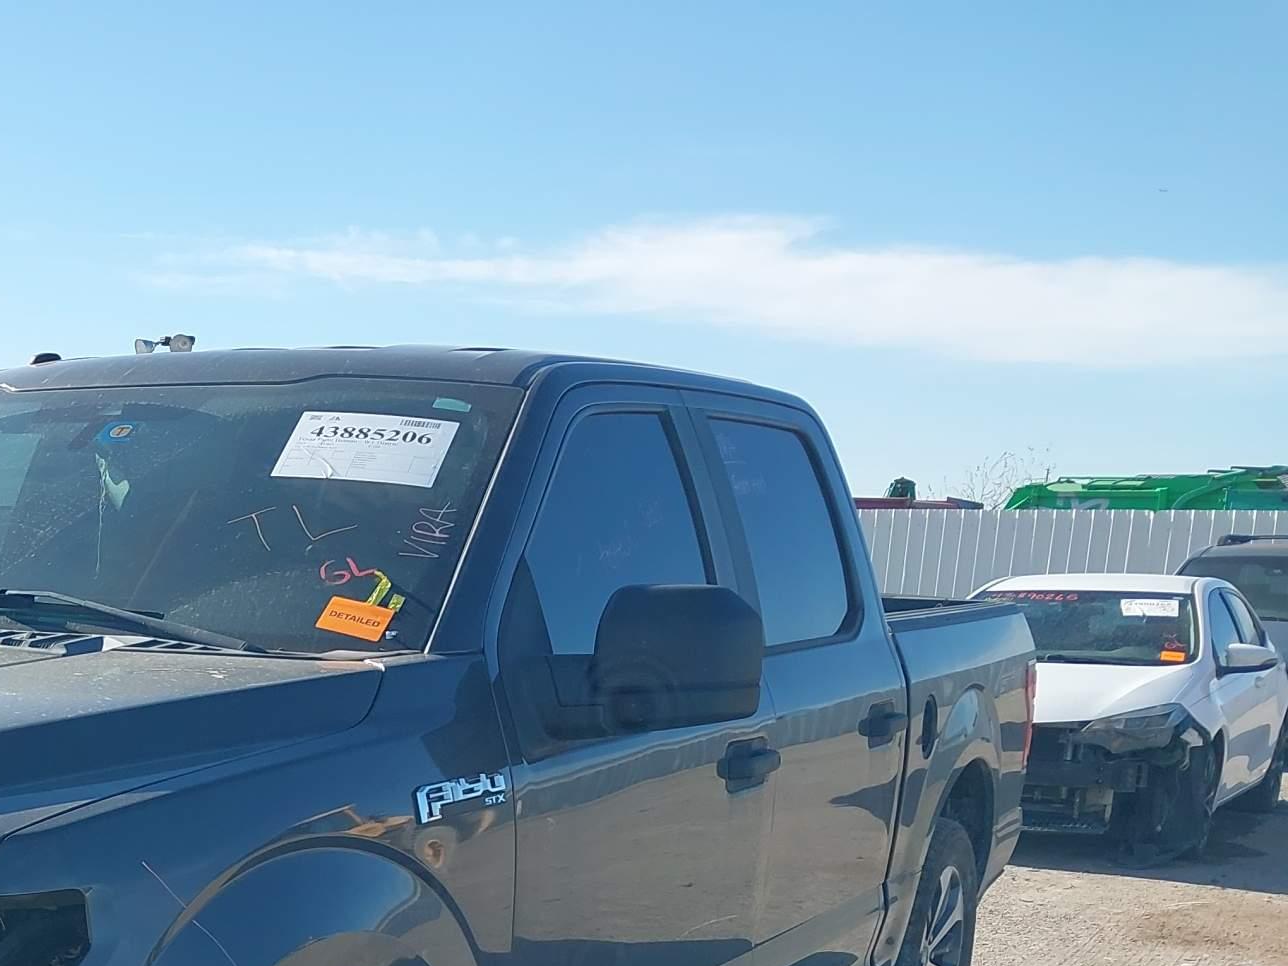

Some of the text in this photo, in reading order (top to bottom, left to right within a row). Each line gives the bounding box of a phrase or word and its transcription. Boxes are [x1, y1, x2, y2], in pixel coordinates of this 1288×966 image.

[309, 424, 433, 446] 43885206
[329, 609, 381, 628] DETAILED
[484, 793, 506, 806] STX
